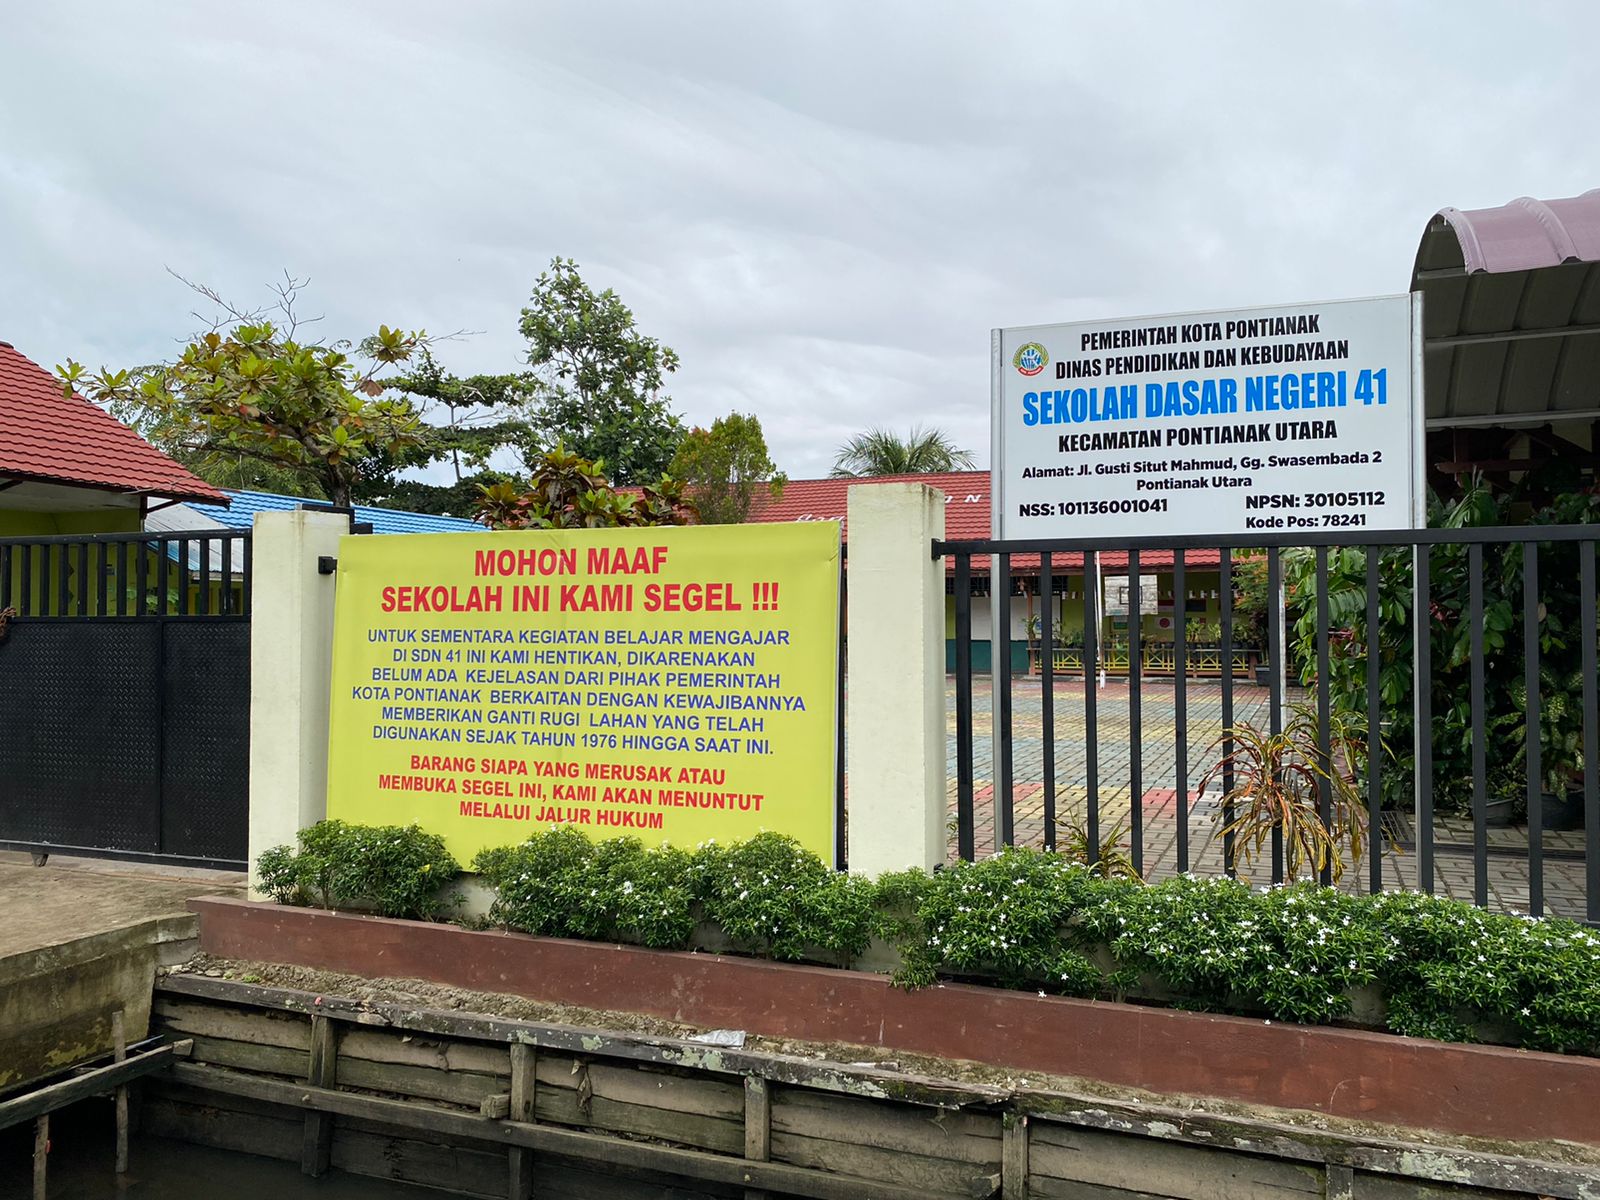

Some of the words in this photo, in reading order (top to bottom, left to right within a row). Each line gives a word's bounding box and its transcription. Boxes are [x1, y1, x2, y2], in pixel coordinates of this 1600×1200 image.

[1082, 326, 1177, 351] PEMERINTAH
[1182, 323, 1222, 343] KOTA
[1226, 315, 1319, 339] PONTIANAK
[1056, 359, 1101, 379] DINAS
[1106, 351, 1199, 375] PENDIDIKAN
[1204, 348, 1236, 368] DAN
[1240, 340, 1348, 365] KEBUDAYAAN
[1023, 384, 1138, 427] SEKOLAH
[1145, 378, 1238, 419] DASAR
[1245, 370, 1348, 413] NEGERI
[1354, 368, 1388, 406] 41
[1059, 430, 1161, 452] KECAMATAN
[1167, 424, 1270, 446] PONTIANAK
[1276, 420, 1337, 441] UTARA
[1022, 466, 1073, 478] Alamat:
[1077, 464, 1092, 475] Jl.
[1095, 462, 1130, 474] Gusti
[1134, 461, 1167, 473] Situt
[1171, 457, 1237, 471] Mahmud,
[1241, 457, 1264, 470] Gg.
[1268, 452, 1368, 467] Swasembada
[1373, 451, 1381, 462] 2
[1137, 477, 1208, 490] Pontianak
[1212, 477, 1252, 487] Utara
[1020, 504, 1054, 516] NSS:
[1058, 499, 1167, 515] 101136001041
[1246, 495, 1299, 509] NPSN:
[1304, 492, 1385, 507] 30105112
[1246, 516, 1283, 528] Kode
[1288, 516, 1318, 527] Pos:
[1322, 514, 1365, 526] 78241
[475, 549, 577, 576] MOHON
[587, 546, 667, 575] MAAF
[382, 586, 502, 612] SEKOLAH
[513, 586, 550, 612] INI
[560, 584, 633, 612] KAMI
[644, 583, 742, 612] SEGEL
[753, 582, 779, 611] !!!
[369, 630, 416, 642] UNTUK
[422, 630, 514, 643] SEMENTARA
[519, 630, 598, 643] KEGIATAN
[605, 631, 683, 644] BELAJAR
[689, 631, 789, 644] MENGAJAR
[394, 649, 406, 661] DI
[412, 649, 441, 662] SDN
[446, 650, 460, 662] 41
[467, 650, 485, 663] INI
[491, 650, 529, 663] KAMI
[535, 651, 621, 667] HENTIKAN,
[628, 651, 754, 666] DIKARENAKAN
[373, 668, 422, 681] BELUM
[426, 669, 457, 682] ADA
[466, 670, 558, 684] KEJELASAN
[565, 671, 603, 685] DARI
[609, 672, 660, 686] PIHAK
[666, 673, 779, 688] PEMERINTAH
[353, 687, 390, 700] KOTA
[395, 688, 480, 703] PONTIANAK
[491, 690, 580, 705] BERKAITAN
[587, 692, 657, 707] DENGAN
[664, 694, 805, 711] KEWAJIBANNYA
[383, 707, 482, 722] MEMBERIKAN
[488, 710, 534, 724] GANTI
[541, 712, 579, 726] RUGI
[590, 713, 646, 728] LAHAN
[653, 715, 699, 730] YANG
[705, 717, 763, 732] TELAH
[374, 726, 460, 742] DIGUNAKAN
[466, 729, 516, 744] SEJAK
[522, 732, 575, 746] TAHUN
[582, 734, 616, 748] 1976
[623, 735, 689, 751] HINGGA
[695, 738, 741, 753] SAAT
[747, 739, 773, 754] INI.
[411, 756, 476, 773] BARANG
[482, 759, 528, 775] SIAPA
[534, 762, 579, 778] YANG
[585, 763, 671, 782] MERUSAK
[678, 768, 725, 785] ATAU
[380, 775, 457, 793] MEMBUKA
[463, 780, 513, 797] SEGEL
[519, 784, 546, 800] INI,
[553, 785, 596, 801] KAMI
[603, 787, 652, 804] AKAN
[658, 790, 764, 811] MENUNTUT
[460, 801, 530, 820] MELALUI
[536, 807, 591, 824] JALUR
[597, 810, 663, 828] HUKUM
